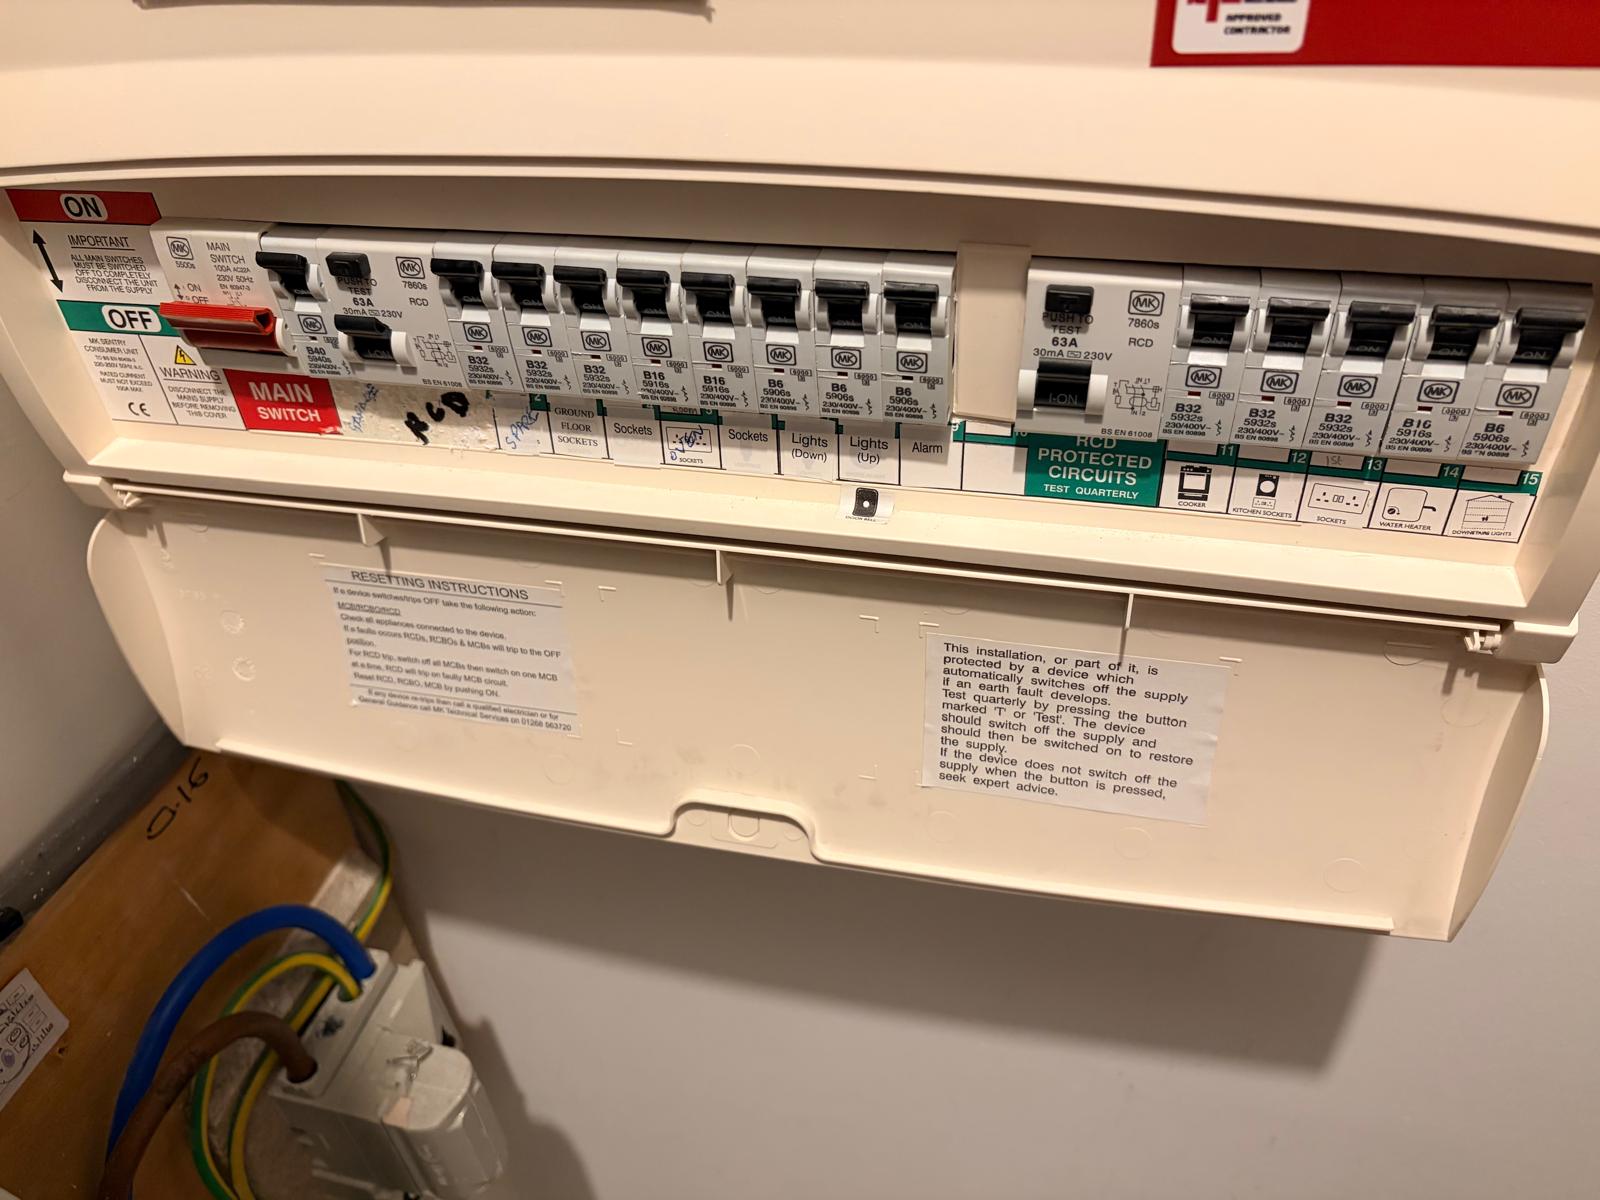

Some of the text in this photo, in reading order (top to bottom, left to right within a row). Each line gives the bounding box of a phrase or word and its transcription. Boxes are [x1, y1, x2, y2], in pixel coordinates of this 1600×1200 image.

[1226, 14, 1282, 22] APPROVED
[1224, 26, 1290, 34] CONTRACTOR
[63, 196, 103, 218] ON
[67, 234, 130, 247] IMPORTANT
[206, 242, 230, 251] MAIN
[105, 256, 144, 264] SWITCHES
[210, 254, 245, 264] SWITCH
[107, 263, 146, 271] SWITCHED
[175, 261, 196, 269] 5500s
[104, 271, 151, 279] COMPLETELY
[217, 274, 233, 282] 230V
[337, 277, 364, 286] PUSH
[402, 281, 428, 290] 7860s
[187, 283, 201, 292] ON
[349, 287, 372, 296] TEST
[192, 296, 209, 304] OFF
[353, 297, 374, 307] 63A
[409, 297, 428, 307] RCD
[342, 307, 402, 318] 30mA 230V
[108, 308, 153, 330] OFF
[1042, 312, 1094, 324] PUSH TO
[1128, 318, 1160, 329] 7860s
[1052, 325, 1082, 334] TEST
[1052, 337, 1078, 347] 63A
[1128, 338, 1153, 347] RCD
[306, 346, 326, 355] B40
[1033, 349, 1112, 360] 30mA 230V
[468, 356, 488, 365] B32
[526, 360, 548, 369] B32
[159, 366, 221, 380] WARNING
[468, 365, 494, 373] 5932s
[584, 365, 606, 374] B32
[584, 374, 610, 382] 5932s
[643, 371, 665, 380] B16
[704, 376, 725, 385] B16
[768, 379, 783, 388] B6
[832, 383, 847, 392] B6
[248, 381, 315, 403] MAIN
[702, 385, 730, 393] 5916s
[763, 388, 791, 397] 5906s
[896, 387, 912, 396] B6
[890, 396, 919, 405] 5906s
[555, 407, 594, 418] GROUND
[1175, 403, 1201, 413] B32
[257, 407, 321, 423] SWITCH
[1171, 413, 1203, 422] 5932s
[1249, 408, 1275, 419] B32
[1325, 414, 1352, 423] B32
[561, 421, 591, 432] FLOOR
[614, 422, 653, 435] Sockets
[1318, 423, 1353, 433] 5932s
[1485, 422, 1505, 433] B6
[728, 429, 768, 442] Sockets
[1128, 430, 1152, 438] 61008
[1396, 429, 1432, 438] 5916s
[1473, 433, 1510, 443] 5906s
[558, 435, 598, 447] SOCKETS
[792, 433, 828, 448] Lights
[850, 436, 888, 451] Lights
[1076, 435, 1116, 449] RCD
[912, 442, 943, 453] Alarm
[1220, 445, 1234, 456] 11
[792, 449, 828, 463] (Down)
[857, 452, 880, 465] (Up)
[1038, 448, 1152, 469] PROTECTED
[1291, 452, 1307, 463] 12
[1366, 459, 1382, 470] 13
[1048, 466, 1137, 485] CIRCUITS
[1443, 466, 1459, 477] 14
[1522, 473, 1539, 484] 15
[1043, 484, 1139, 499] TEST QUARTERLY
[1232, 507, 1292, 518] KITCHEN SOCKETS
[1316, 516, 1346, 524] SOCKETS
[1380, 521, 1431, 531] WATER HEATER
[351, 571, 528, 600] RESETTING INSTRUCTIONS
[423, 597, 535, 616] OFF take the following action:
[943, 642, 1158, 676] This installation, or part of it, is
[538, 672, 557, 681] MCB
[943, 667, 1188, 705] automatically switches off the supply
[942, 688, 1187, 728] Test quarterly by pressing the button
[941, 712, 1156, 748] should switch off the supply and
[940, 736, 1007, 755] the supply.
[941, 725, 1193, 765] should then be switched on to restore
[938, 772, 1058, 796] seek expert advice.
[939, 760, 1165, 800] supply when the button is pressed,
